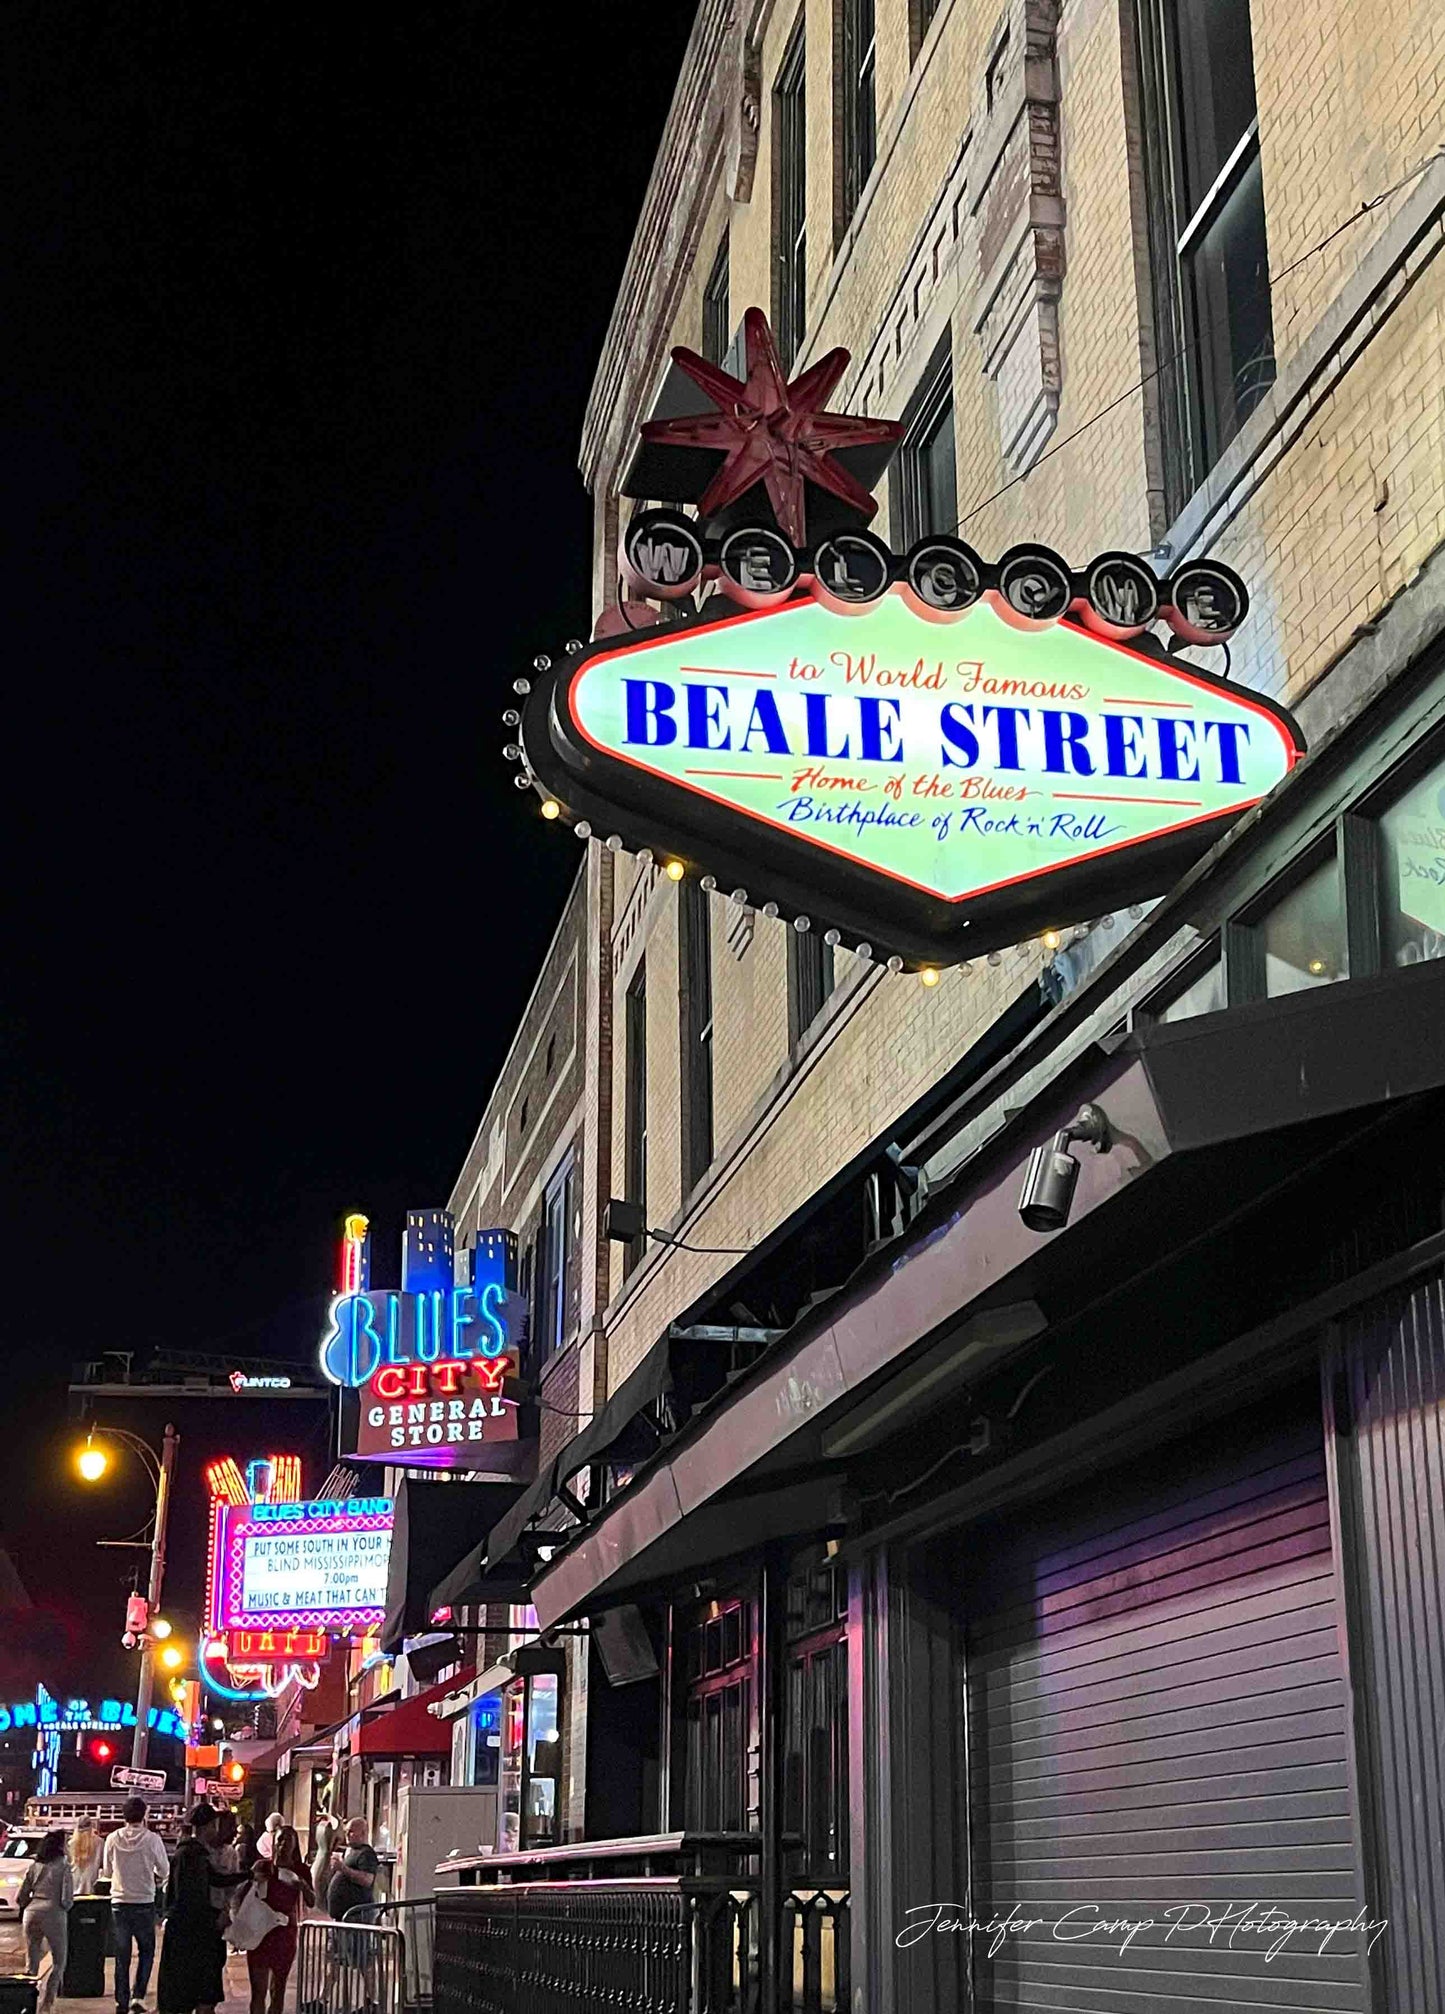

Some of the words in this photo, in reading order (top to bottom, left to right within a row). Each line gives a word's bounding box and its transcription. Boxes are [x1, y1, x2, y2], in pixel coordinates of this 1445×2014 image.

[788, 658, 825, 682] to
[828, 651, 948, 691] World
[956, 664, 1090, 702] Famous
[619, 678, 903, 763] BEALE
[939, 701, 1251, 786] STREET
[790, 766, 878, 794] Home
[884, 774, 902, 800] of
[911, 774, 955, 800] the
[960, 777, 1043, 803] Blues
[777, 798, 925, 839] Birthplace
[932, 811, 948, 837] of
[352, 1283, 506, 1387] BLUES
[371, 1356, 508, 1399] CITY
[368, 1397, 506, 1427] GENERAL
[391, 1420, 483, 1447] STORE
[253, 1502, 305, 1521] BLUES
[308, 1500, 345, 1518] CITY
[346, 1496, 394, 1517] BAND
[254, 1541, 271, 1557] PUT
[274, 1540, 300, 1555] SOME
[302, 1537, 334, 1553] SOUTH
[336, 1536, 348, 1551] IN
[352, 1535, 382, 1551] YOUR
[267, 1557, 300, 1572] BLIND
[303, 1553, 363, 1571] MISSISSIPPI
[249, 1593, 279, 1607] MUSIC
[282, 1592, 291, 1605] &
[295, 1590, 323, 1604] MEAT
[325, 1589, 351, 1603] THAT
